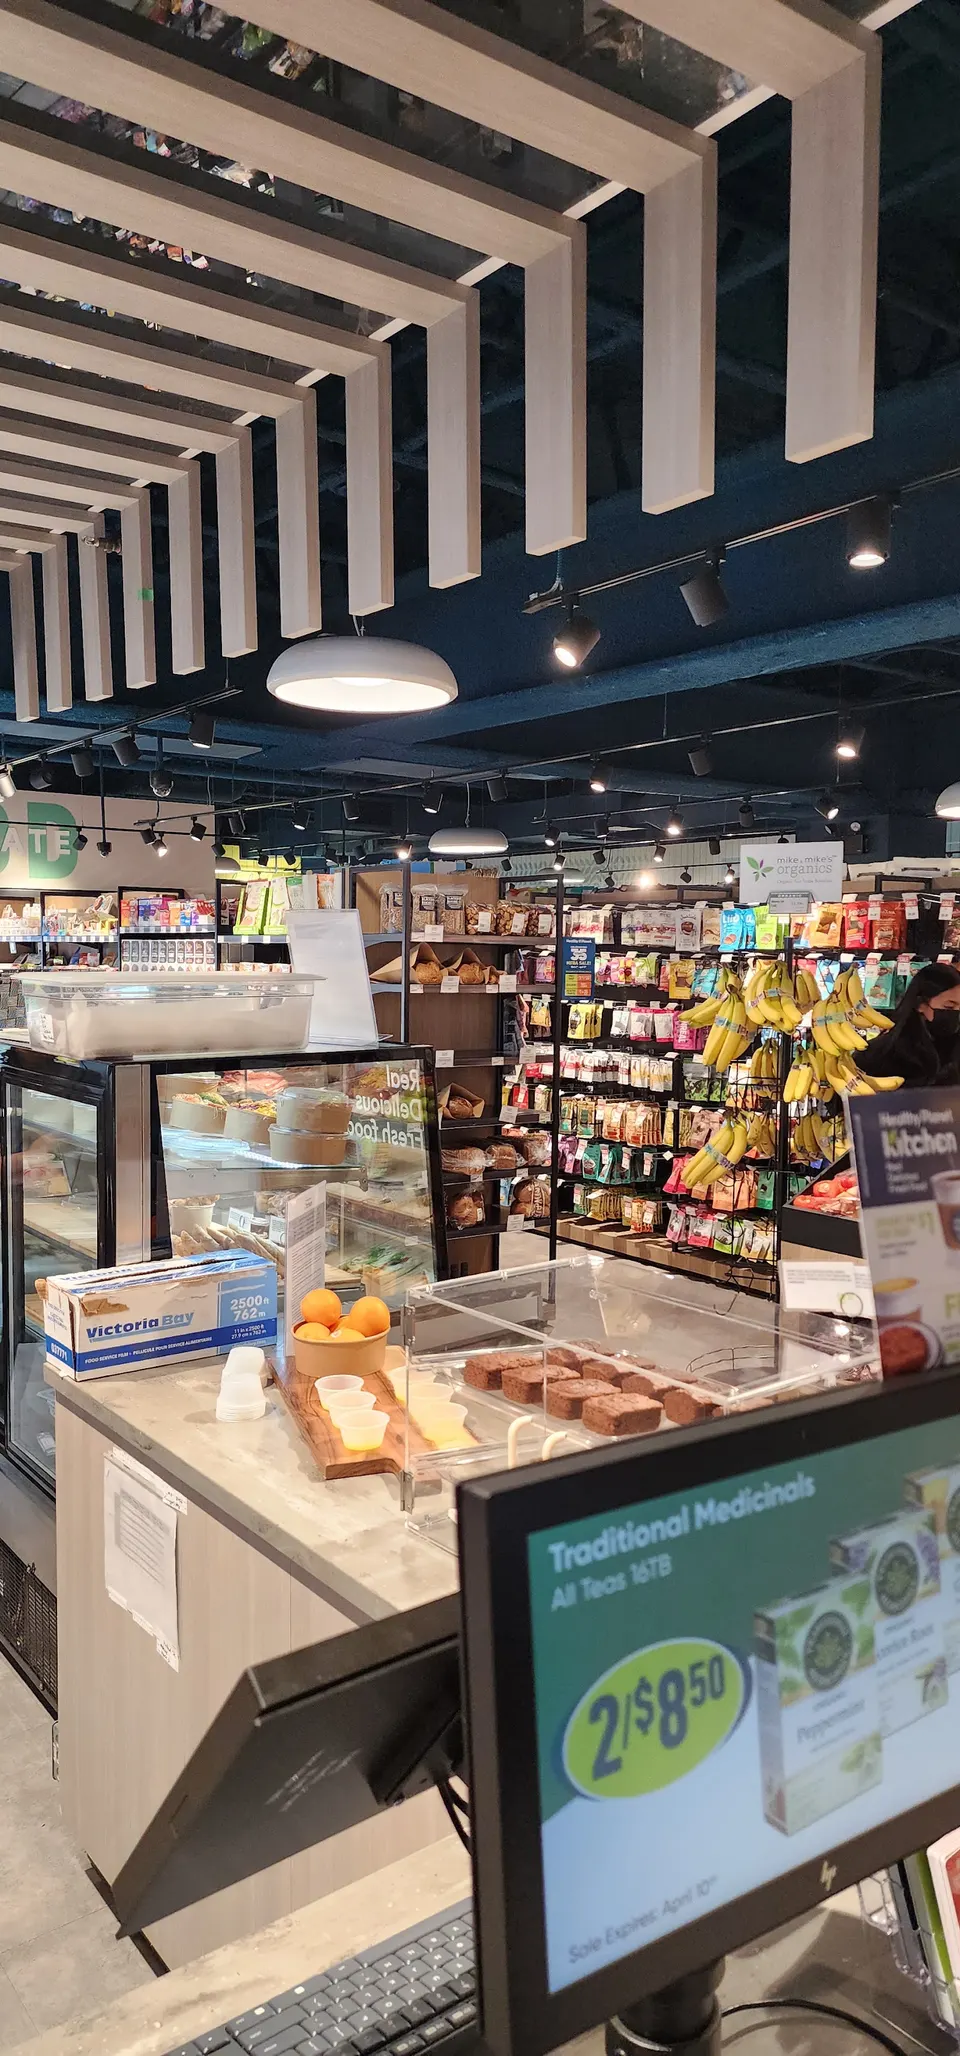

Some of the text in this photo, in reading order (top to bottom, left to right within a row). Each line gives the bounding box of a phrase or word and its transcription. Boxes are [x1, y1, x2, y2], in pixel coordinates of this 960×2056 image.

[0, 802, 79, 878] D
[777, 856, 799, 864] mike
[777, 863, 833, 878] organics
[230, 1295, 262, 1310] 2500
[86, 1318, 159, 1339] Victoria
[161, 1312, 194, 1327] Bay
[233, 1307, 258, 1322] 762
[99, 1353, 118, 1361] SERVICE
[168, 1341, 185, 1350] SERVICE
[548, 1470, 816, 1573] Traditional Medicinals
[551, 1553, 672, 1612] All Teas 16TB
[568, 1937, 602, 1964] Sale
[604, 1907, 659, 1946] Expires:
[661, 1887, 693, 1917] April
